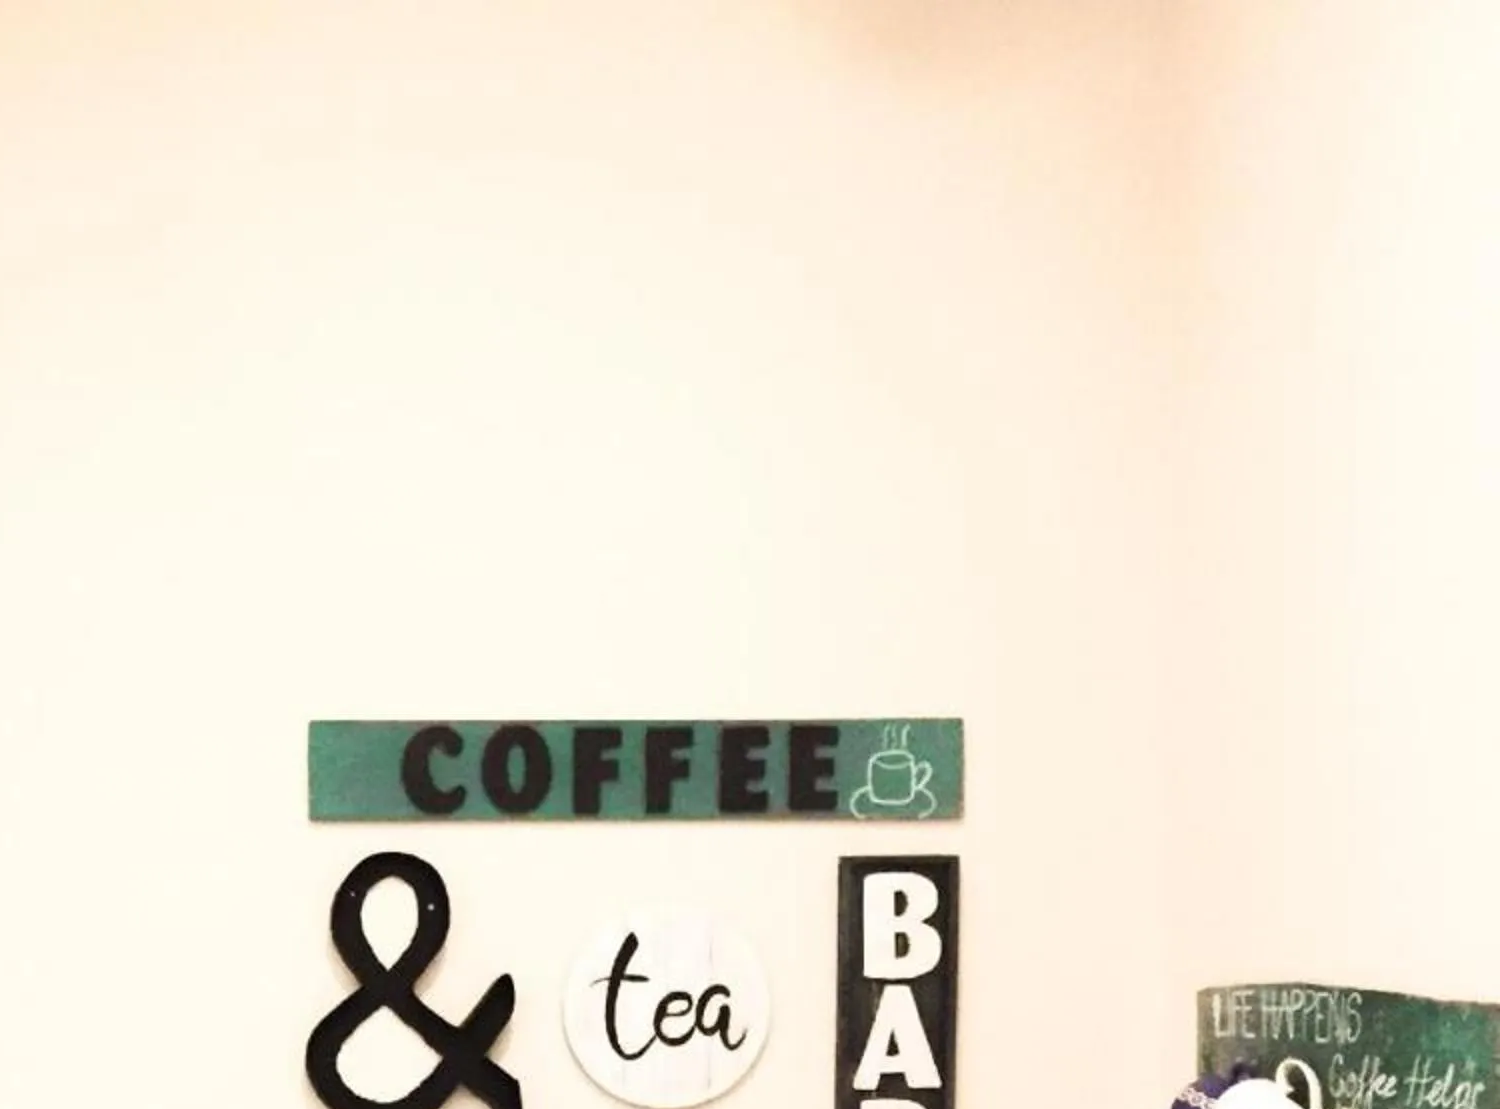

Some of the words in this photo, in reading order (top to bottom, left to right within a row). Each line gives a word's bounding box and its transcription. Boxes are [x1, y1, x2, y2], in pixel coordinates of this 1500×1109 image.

[401, 724, 841, 815] COFFEE
[590, 931, 748, 1061] tea
[1211, 989, 1256, 1040] LIFE
[1260, 988, 1364, 1045] HAPPENS
